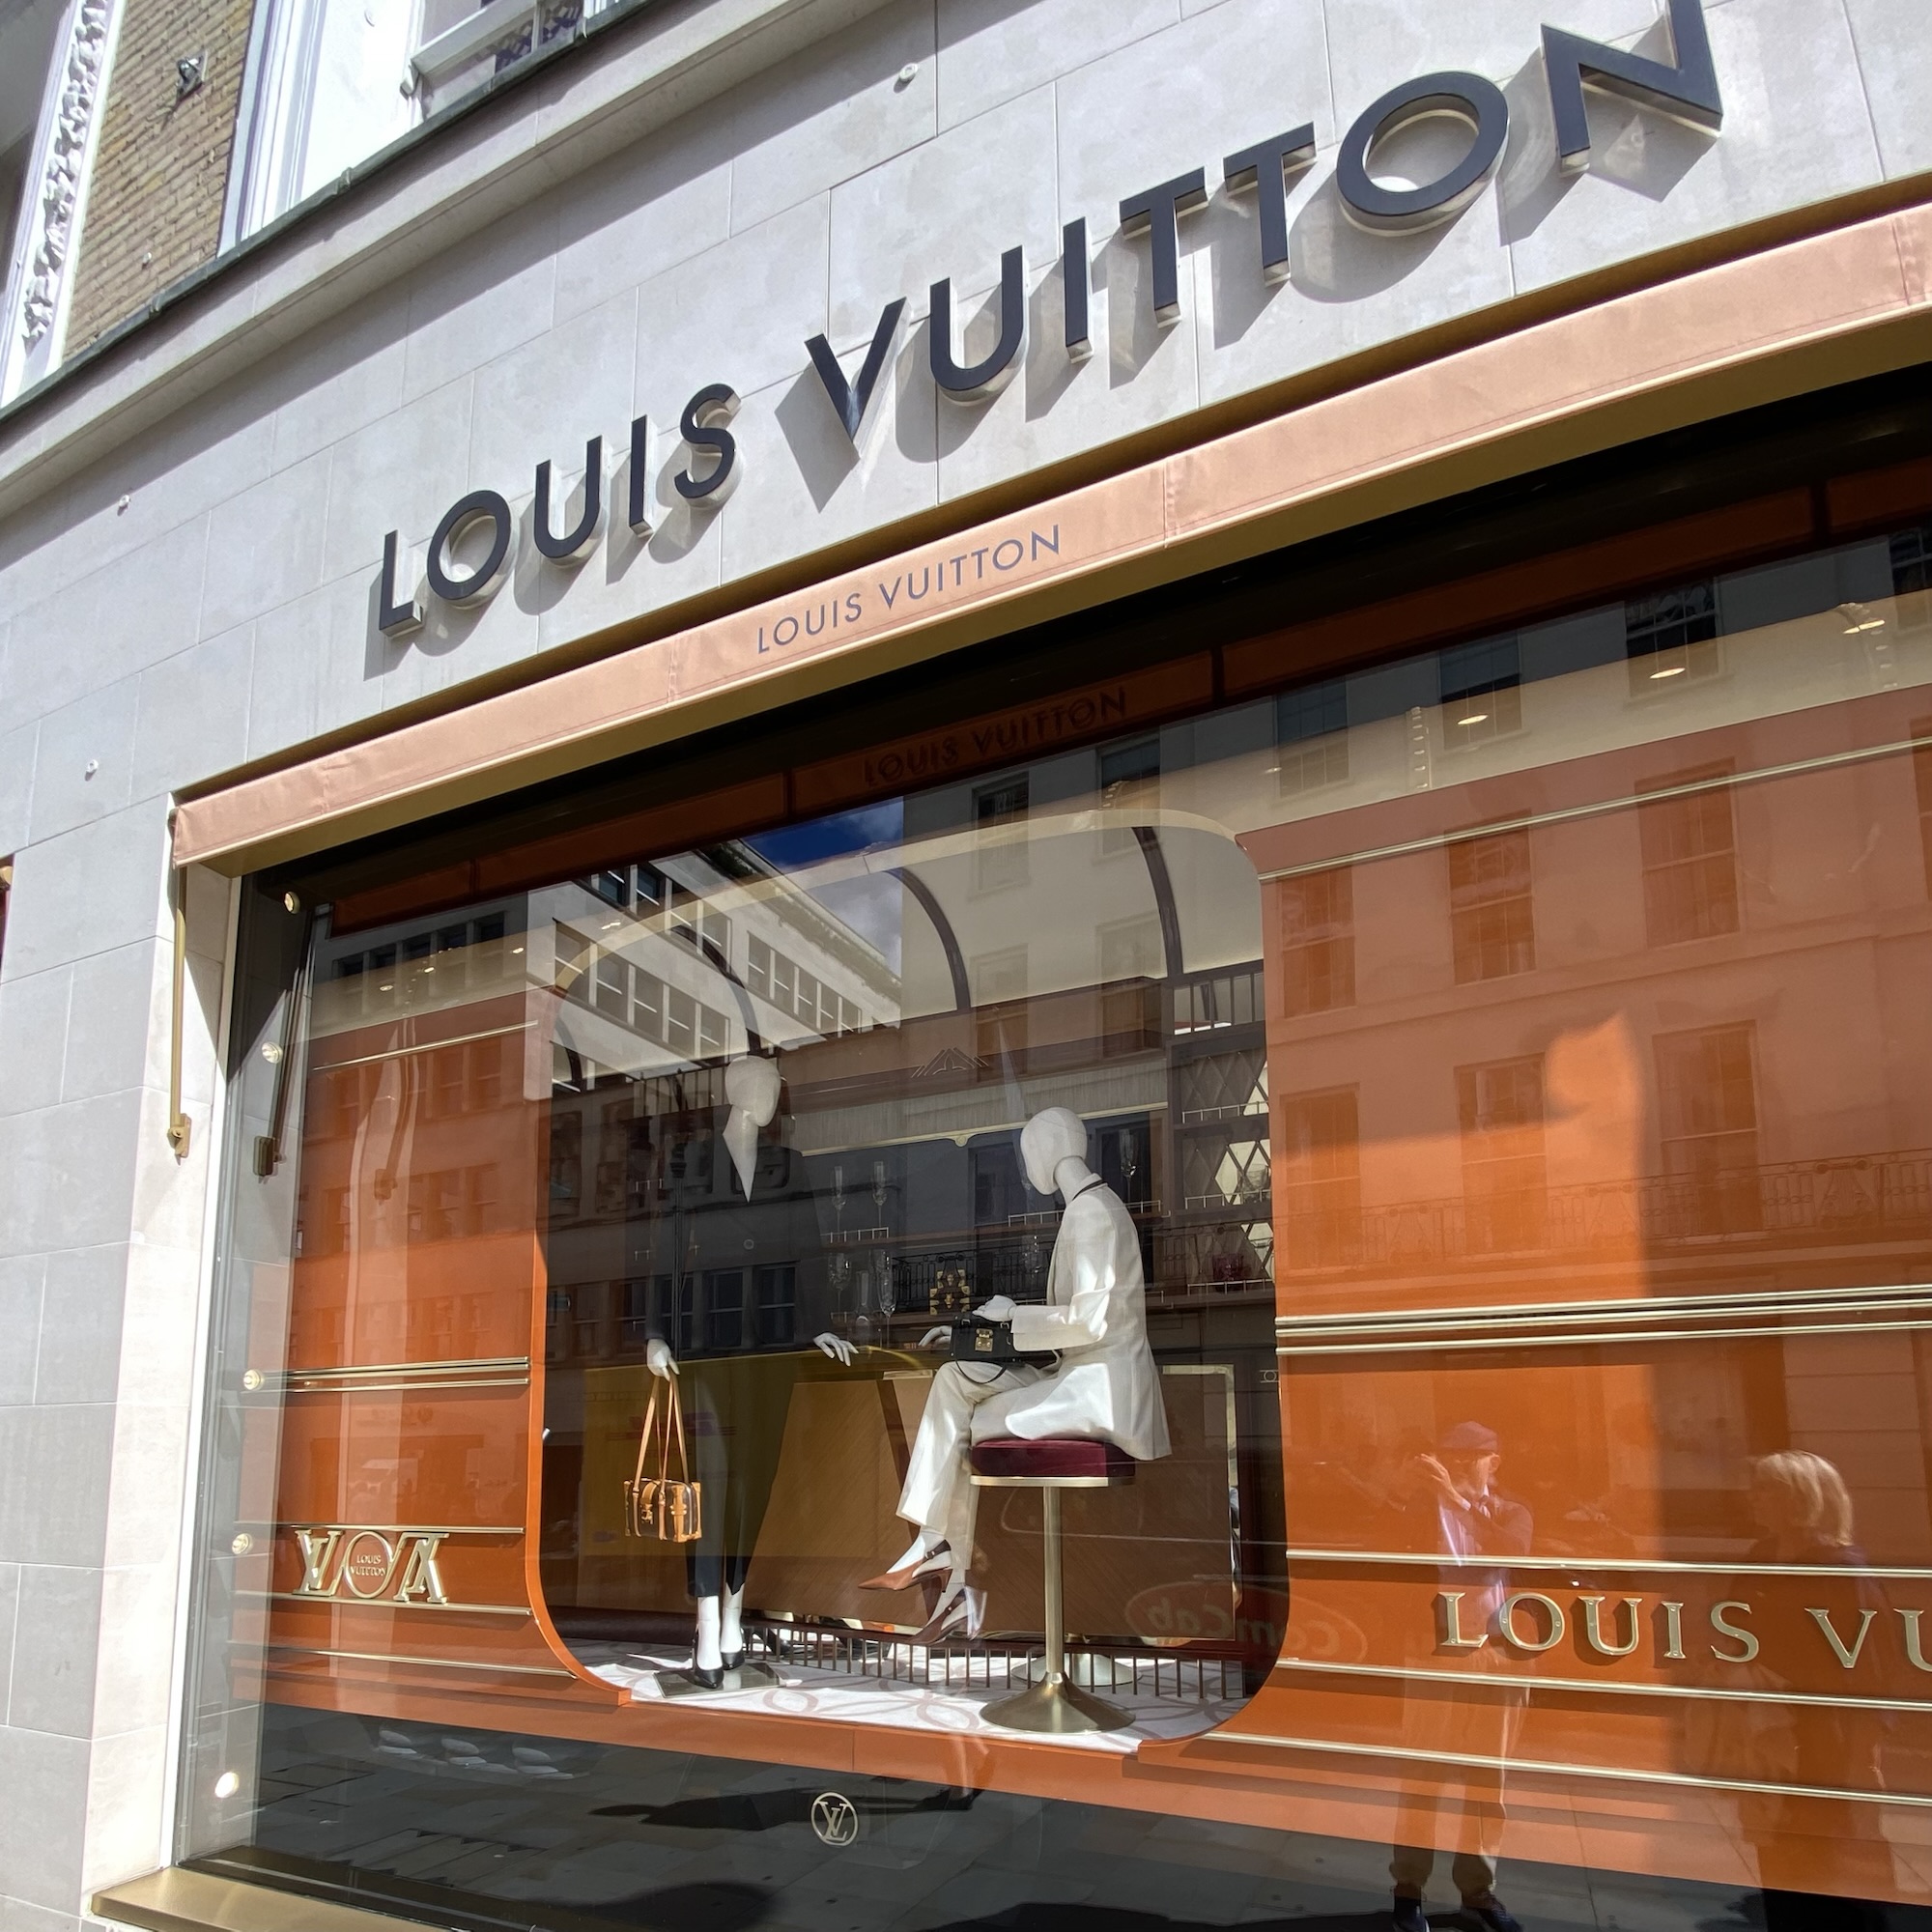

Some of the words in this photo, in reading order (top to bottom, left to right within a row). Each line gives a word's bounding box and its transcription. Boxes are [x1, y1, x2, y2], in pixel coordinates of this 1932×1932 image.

[379, 383, 742, 638] LOUIS
[804, 0, 1723, 446] VUITTON
[757, 592, 863, 654] LOUIS
[878, 524, 1060, 610] VUITTON
[865, 736, 958, 787] LOUIS
[973, 686, 1126, 757] VUITTON
[350, 1566, 386, 1577] VUITTON
[355, 1554, 382, 1565] LOUIS
[1437, 1591, 1760, 1663] LOUIS
